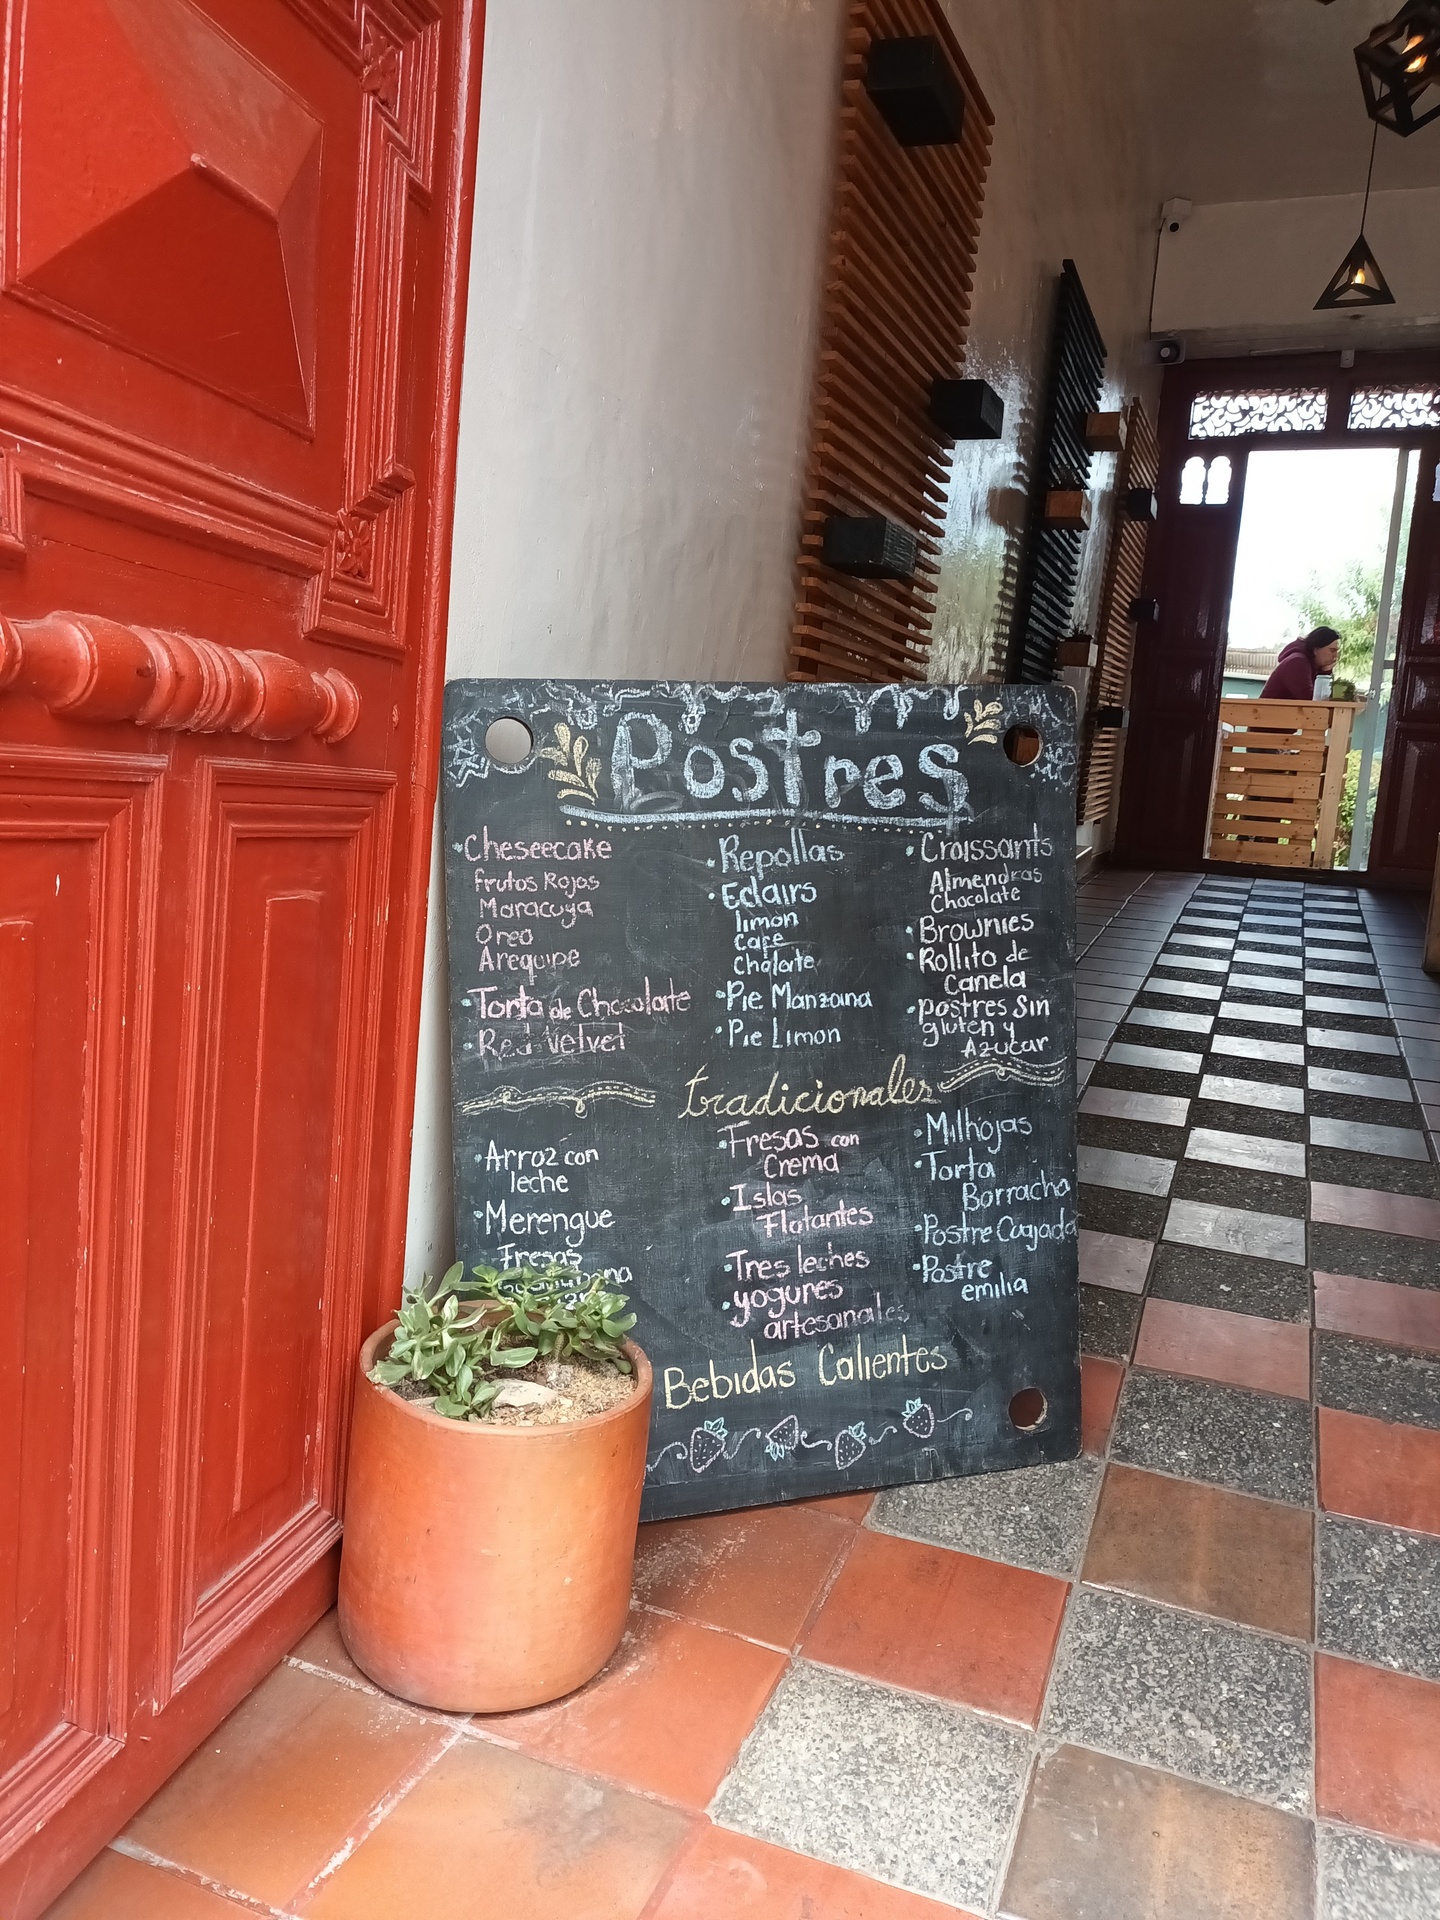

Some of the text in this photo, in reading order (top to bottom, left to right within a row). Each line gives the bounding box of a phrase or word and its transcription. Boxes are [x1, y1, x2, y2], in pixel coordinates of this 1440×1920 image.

[610, 708, 969, 813] Postres
[464, 825, 613, 862] Cheseecake
[719, 827, 846, 880] Repollas
[921, 823, 1053, 863] Croissants
[929, 863, 1043, 895] Almendras
[479, 897, 594, 929] Maracuya
[930, 885, 1021, 914] Chocolate
[475, 923, 534, 947] Oreo
[919, 913, 1035, 944] Brownies
[478, 946, 581, 985] Arequipe
[919, 939, 1032, 974] Rollito de
[727, 980, 873, 1011] Pie Manzana
[944, 964, 1027, 996] Canela
[467, 976, 692, 1020] Torta de Chocolate
[1012, 994, 1051, 1018] Sin
[479, 1023, 532, 1061] Red
[728, 1017, 842, 1048] Pie Limon
[922, 1015, 1015, 1047] gluten y
[960, 1036, 1049, 1059] Azucar
[678, 1053, 942, 1118] tradicionales
[717, 1120, 860, 1158] Fresas con
[926, 1107, 1033, 1154] Milhojas
[484, 1139, 599, 1172] Arroz con
[763, 1152, 840, 1179] Crema
[920, 1147, 996, 1181] Torta
[510, 1169, 569, 1193] leche
[729, 1181, 803, 1212] Islas
[485, 1199, 616, 1247] Merengue
[756, 1199, 874, 1238] Flotantes
[924, 1211, 993, 1246] Postre
[725, 1242, 870, 1282] Tres leches
[921, 1254, 993, 1283] Postre
[730, 1279, 843, 1328] yogures
[961, 1272, 1029, 1302] emilia
[763, 1292, 911, 1341] artesanales
[663, 1334, 948, 1410] Bebidas Calientes
